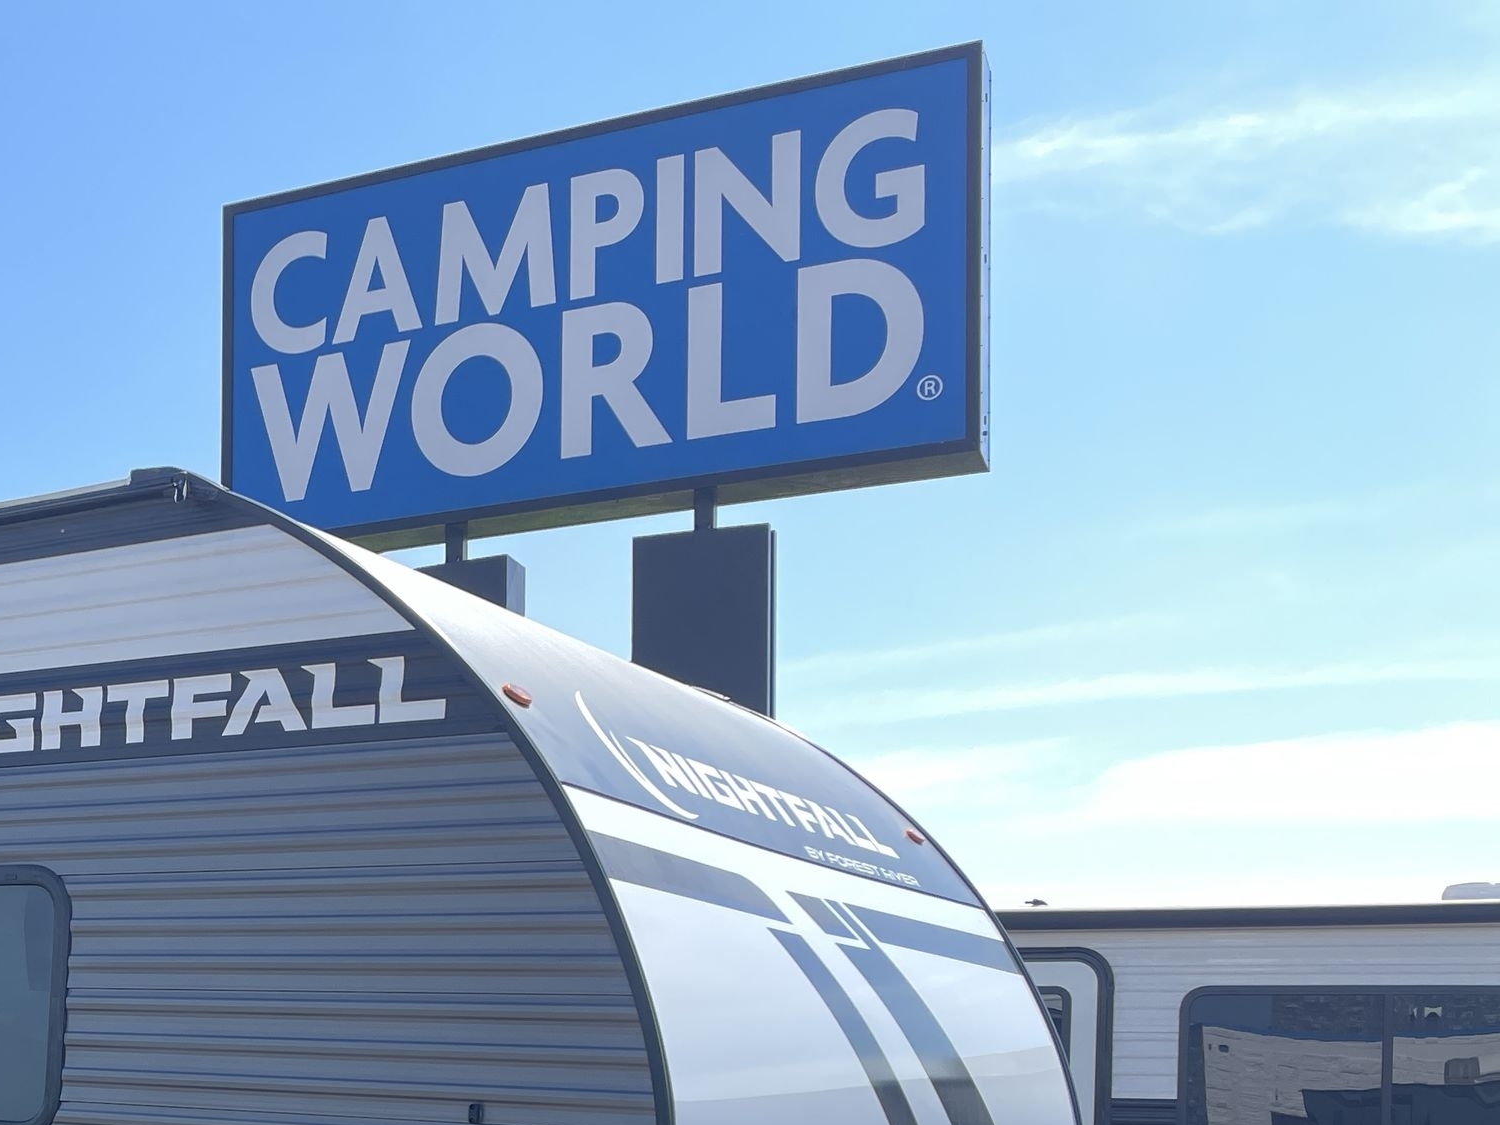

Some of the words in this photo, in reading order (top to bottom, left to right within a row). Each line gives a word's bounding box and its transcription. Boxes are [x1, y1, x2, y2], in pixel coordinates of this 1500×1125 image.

[250, 107, 926, 355] CAMPING
[250, 258, 925, 503] WORLD
[625, 735, 900, 860] NIGHTFALL
[804, 846, 826, 862] BY
[826, 852, 881, 877] FOREST
[881, 867, 921, 888] RIVER
